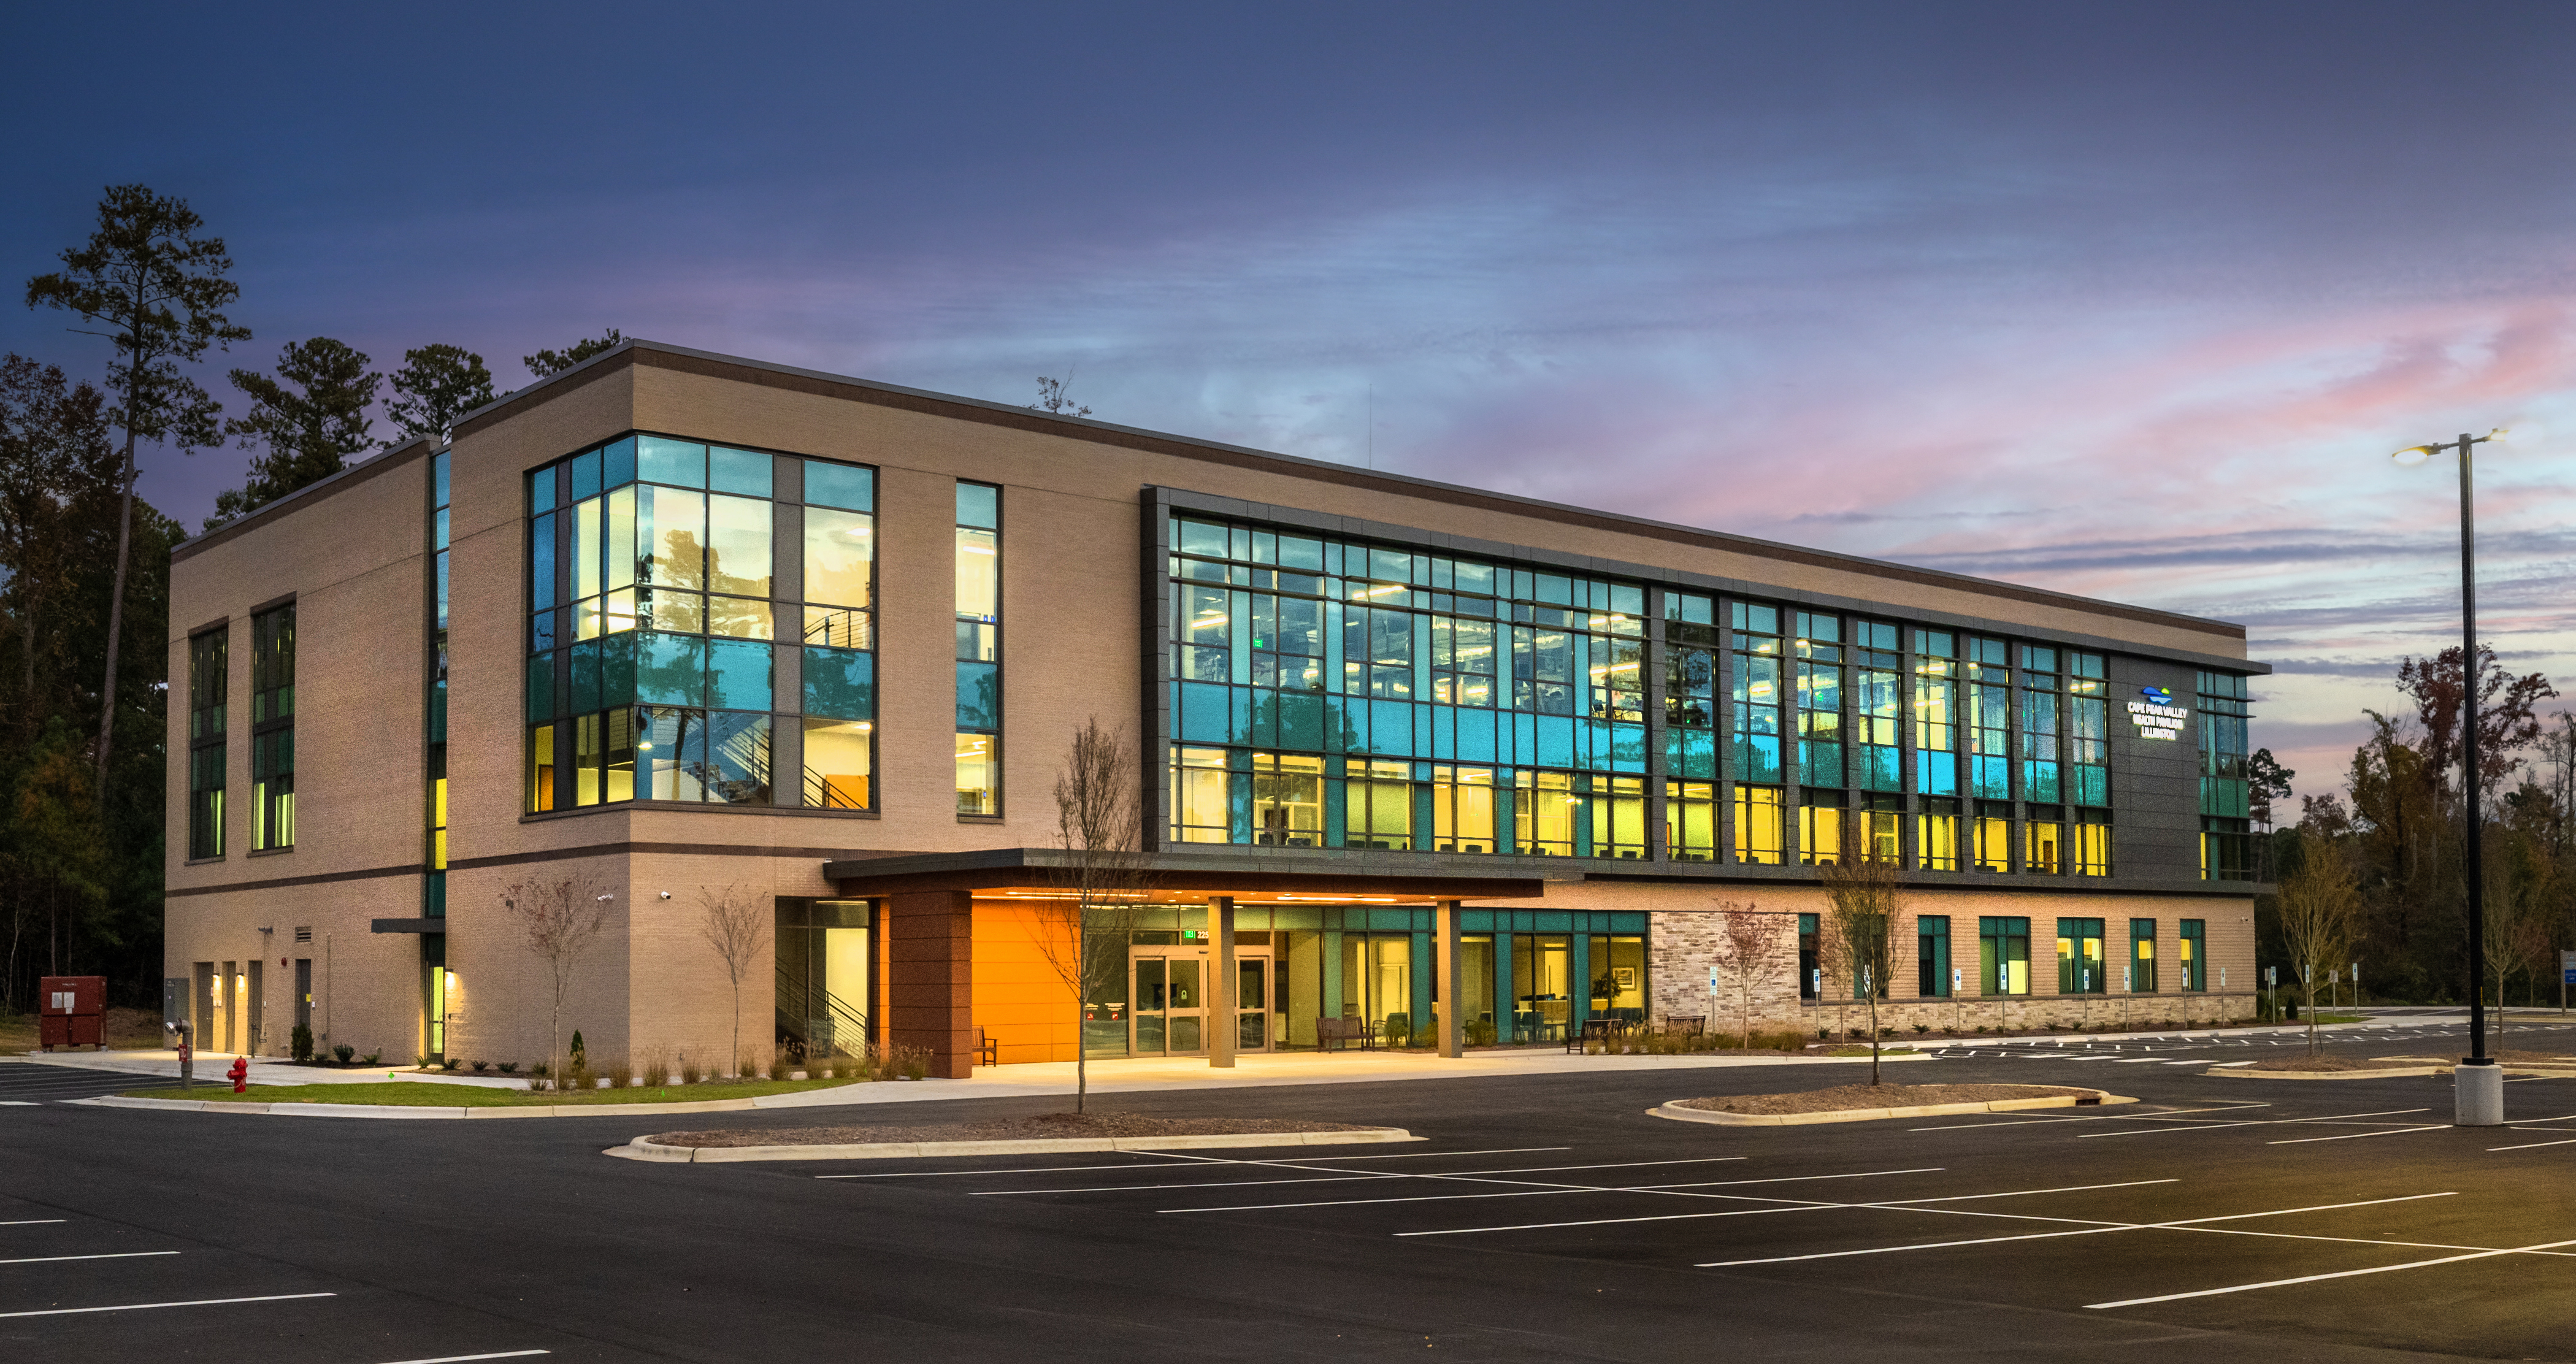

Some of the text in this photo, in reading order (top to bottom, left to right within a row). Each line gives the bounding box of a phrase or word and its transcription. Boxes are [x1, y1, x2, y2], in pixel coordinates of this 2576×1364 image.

[2128, 701, 2188, 719] CAPE FEAR VALLEY
[2133, 713, 2183, 730] HEALTH PAVILION
[2141, 726, 2176, 740] LILLINGTON
[1197, 930, 1209, 939] 225
